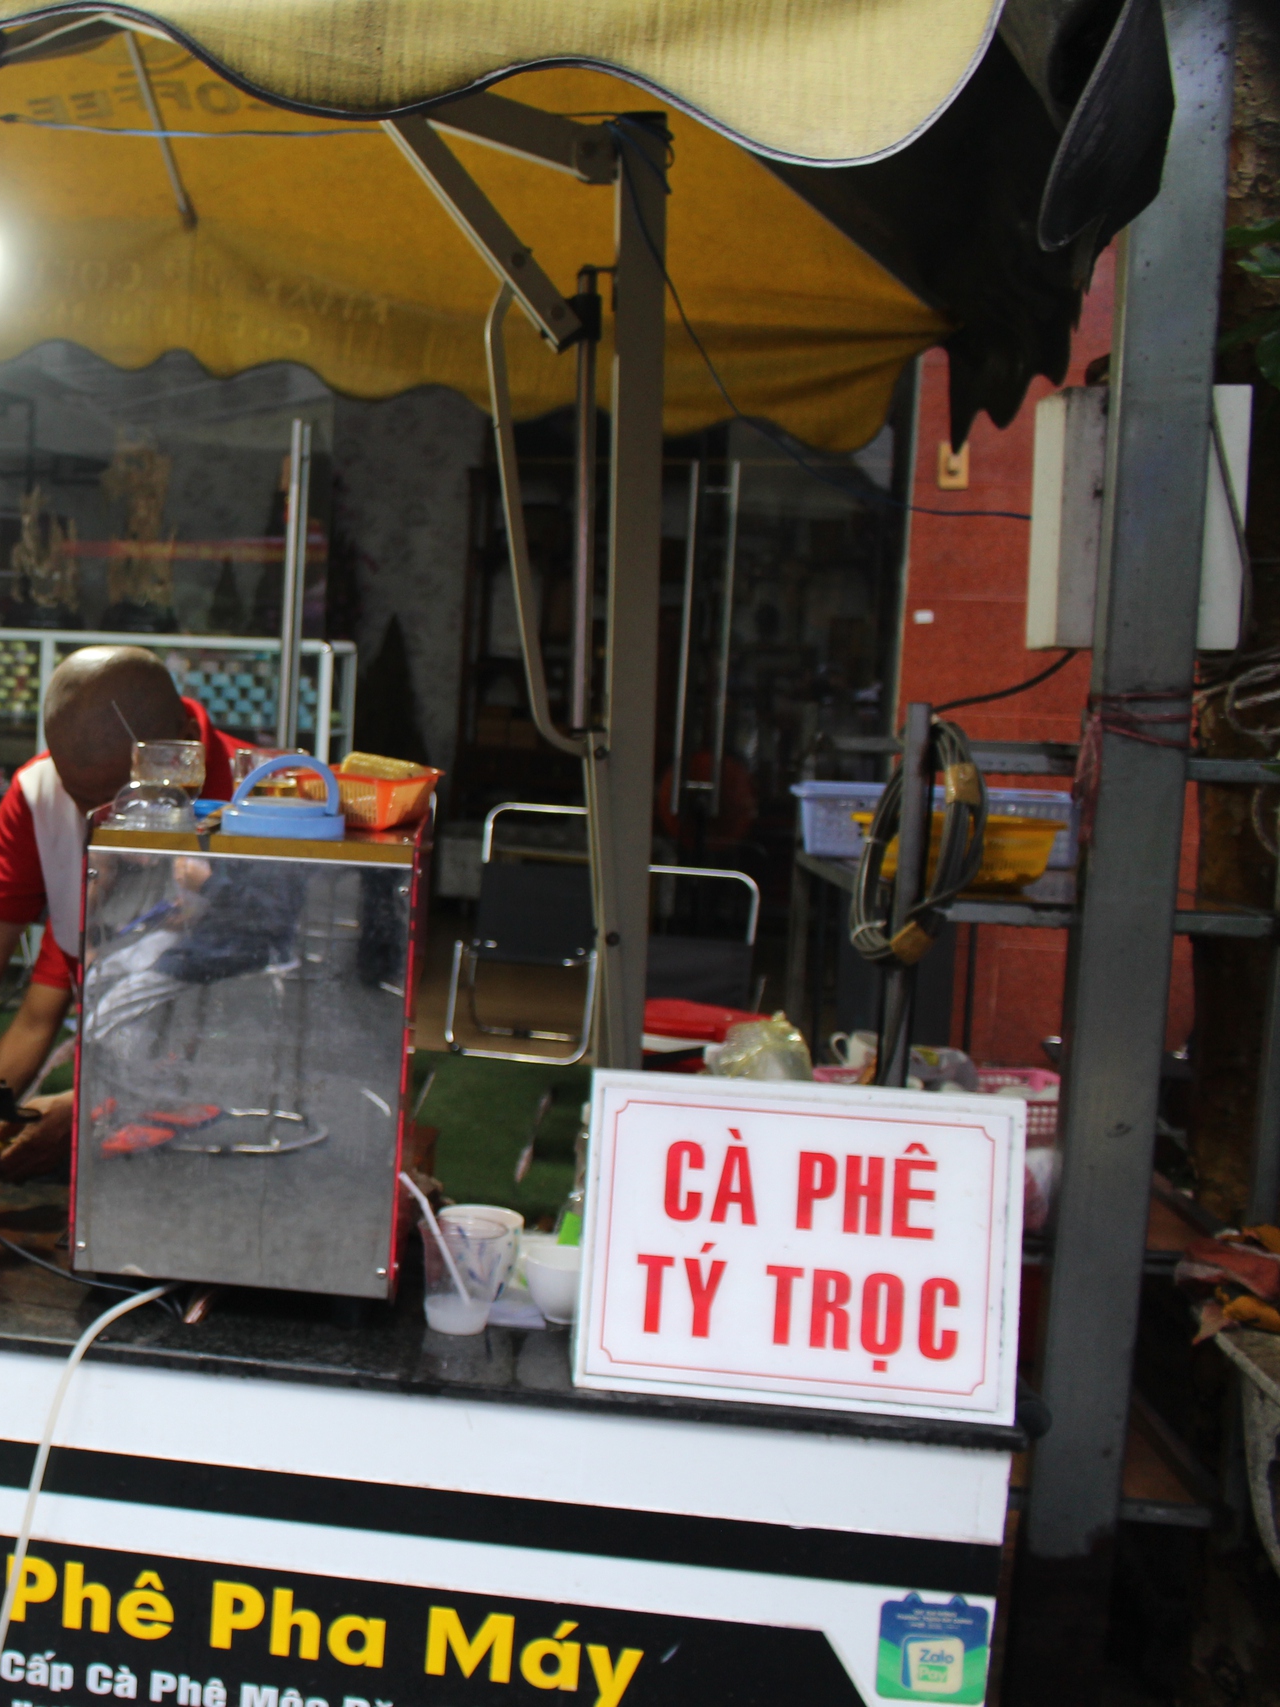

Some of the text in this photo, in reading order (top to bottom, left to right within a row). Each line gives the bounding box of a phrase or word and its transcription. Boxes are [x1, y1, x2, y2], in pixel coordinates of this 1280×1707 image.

[664, 1128, 938, 1240] CÀ PHÊ
[637, 1242, 960, 1373] TÝ TRỌC
[6, 1553, 175, 1641] Phê
[209, 1579, 387, 1669] Pha
[424, 1605, 644, 1707] Máy
[920, 1649, 955, 1664] Zalo
[0, 1650, 74, 1692] Cấp
[86, 1662, 137, 1699] Cà
[149, 1670, 228, 1707] Phê
[919, 1664, 948, 1683] Pay
